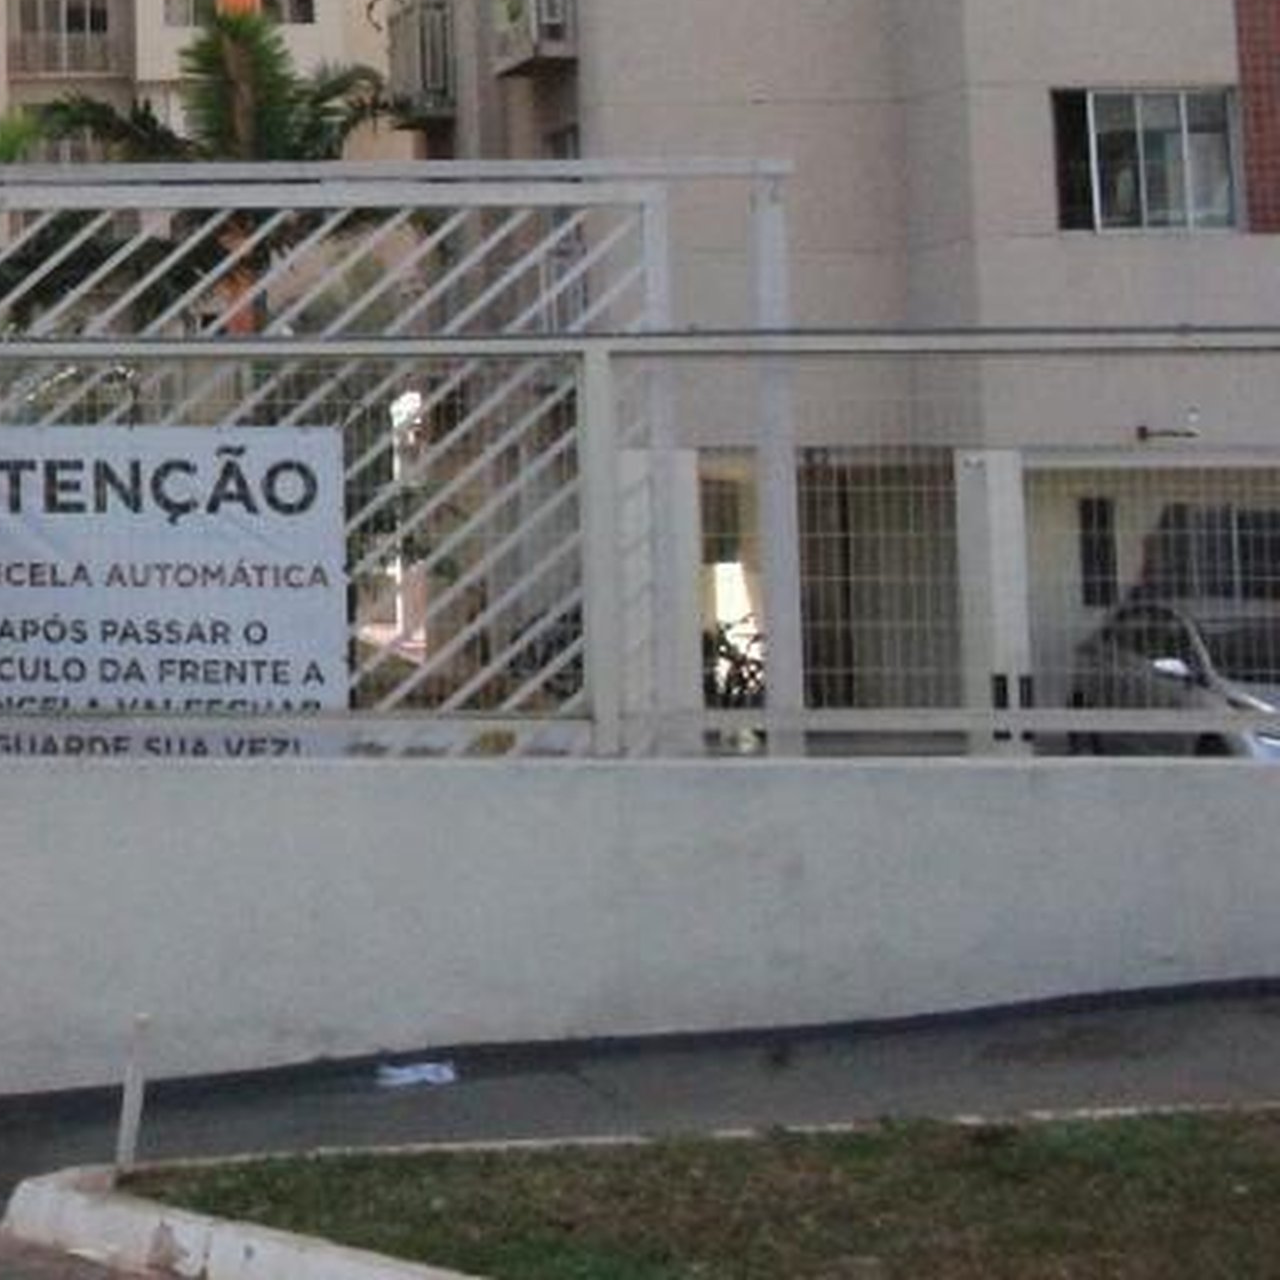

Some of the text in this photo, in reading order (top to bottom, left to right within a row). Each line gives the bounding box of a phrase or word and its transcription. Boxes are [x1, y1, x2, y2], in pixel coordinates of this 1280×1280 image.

[105, 558, 330, 590] AUTOMÁTICA
[100, 618, 232, 645] PASSAR
[243, 620, 269, 646] O
[99, 658, 146, 684] DA
[158, 658, 292, 686] FRENTE
[302, 660, 326, 686] A
